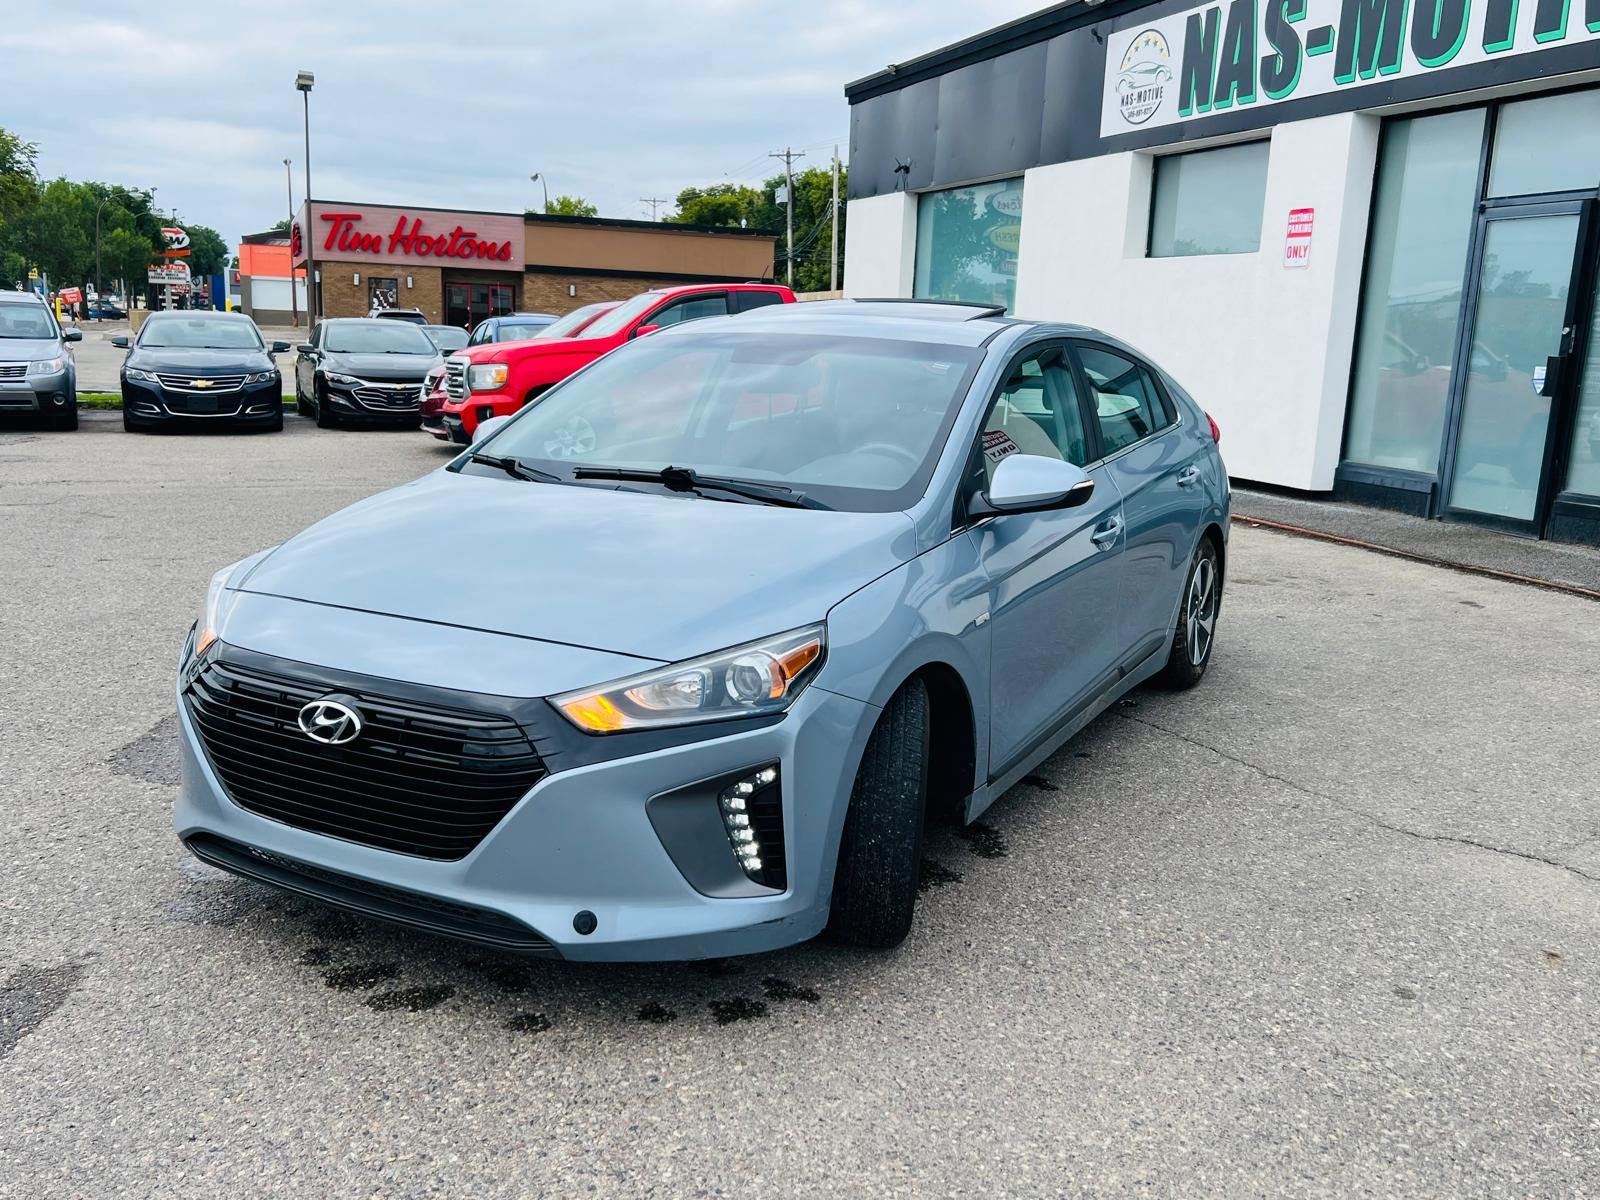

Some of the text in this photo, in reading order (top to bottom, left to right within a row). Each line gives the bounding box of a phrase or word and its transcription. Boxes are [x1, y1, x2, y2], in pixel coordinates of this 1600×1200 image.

[1121, 86, 1164, 107] NAS-MOTIVE
[320, 214, 382, 254] Tim
[388, 215, 512, 261] Hortons
[1287, 245, 1308, 259] ONLY
